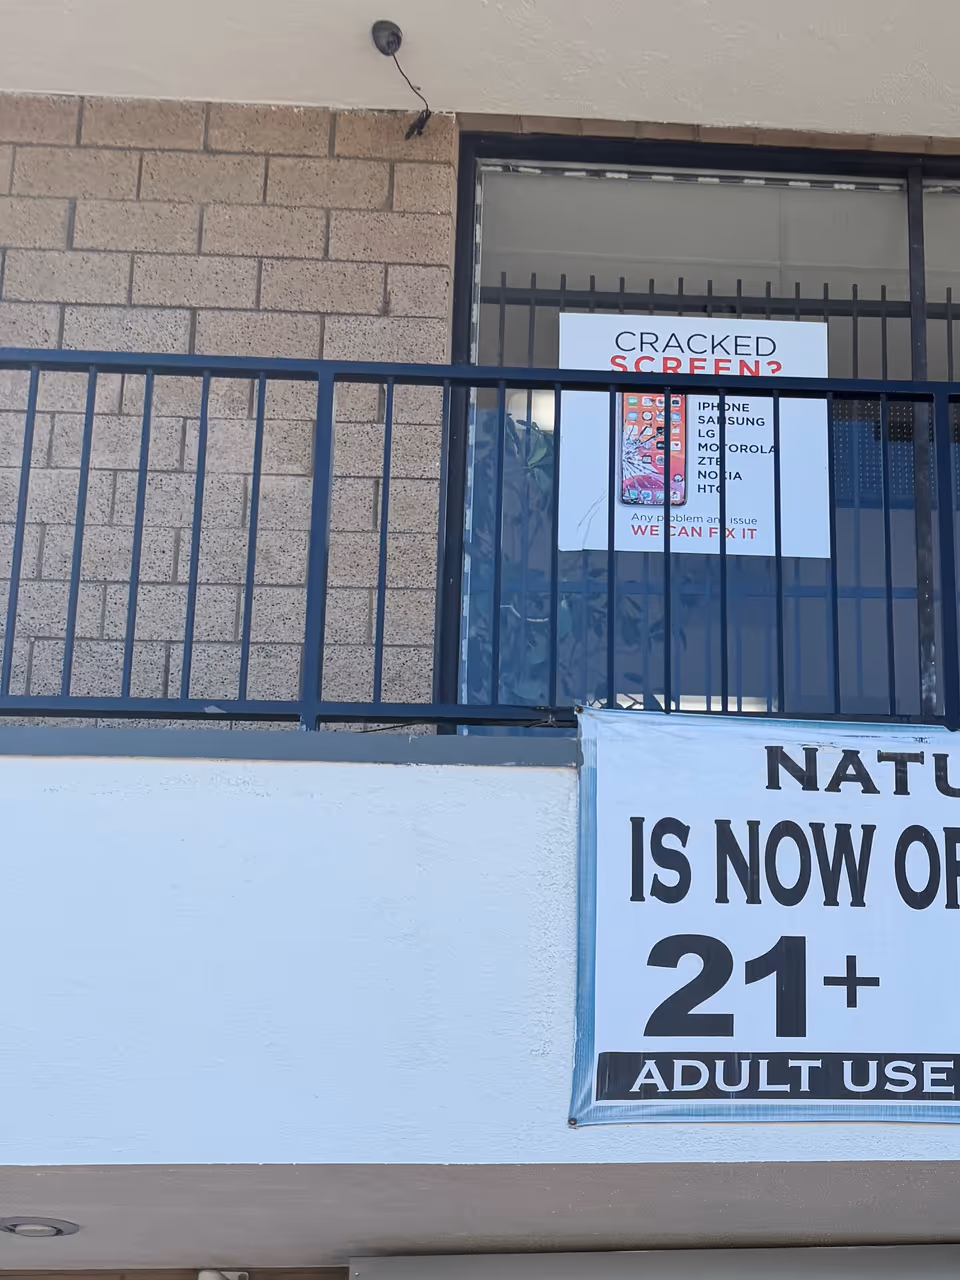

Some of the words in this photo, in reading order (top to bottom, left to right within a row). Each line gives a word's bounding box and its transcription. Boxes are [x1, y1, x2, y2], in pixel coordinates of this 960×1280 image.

[614, 331, 777, 357] CRACKED
[698, 402, 750, 413] IPHONE
[698, 429, 715, 438] LG
[698, 456, 721, 466] ZTE
[697, 470, 742, 480] NOIA
[631, 512, 653, 523] Any
[657, 513, 704, 524] poblem
[706, 516, 721, 524] an
[730, 517, 758, 525] issue
[631, 524, 660, 536] WE
[669, 525, 702, 537] CAN
[708, 526, 736, 539] FX
[742, 528, 757, 540] IT
[629, 816, 693, 904] IS
[714, 819, 877, 908] NOW
[643, 933, 880, 1038] 21+
[629, 1058, 822, 1094] ADULT
[842, 1060, 956, 1095] USE
